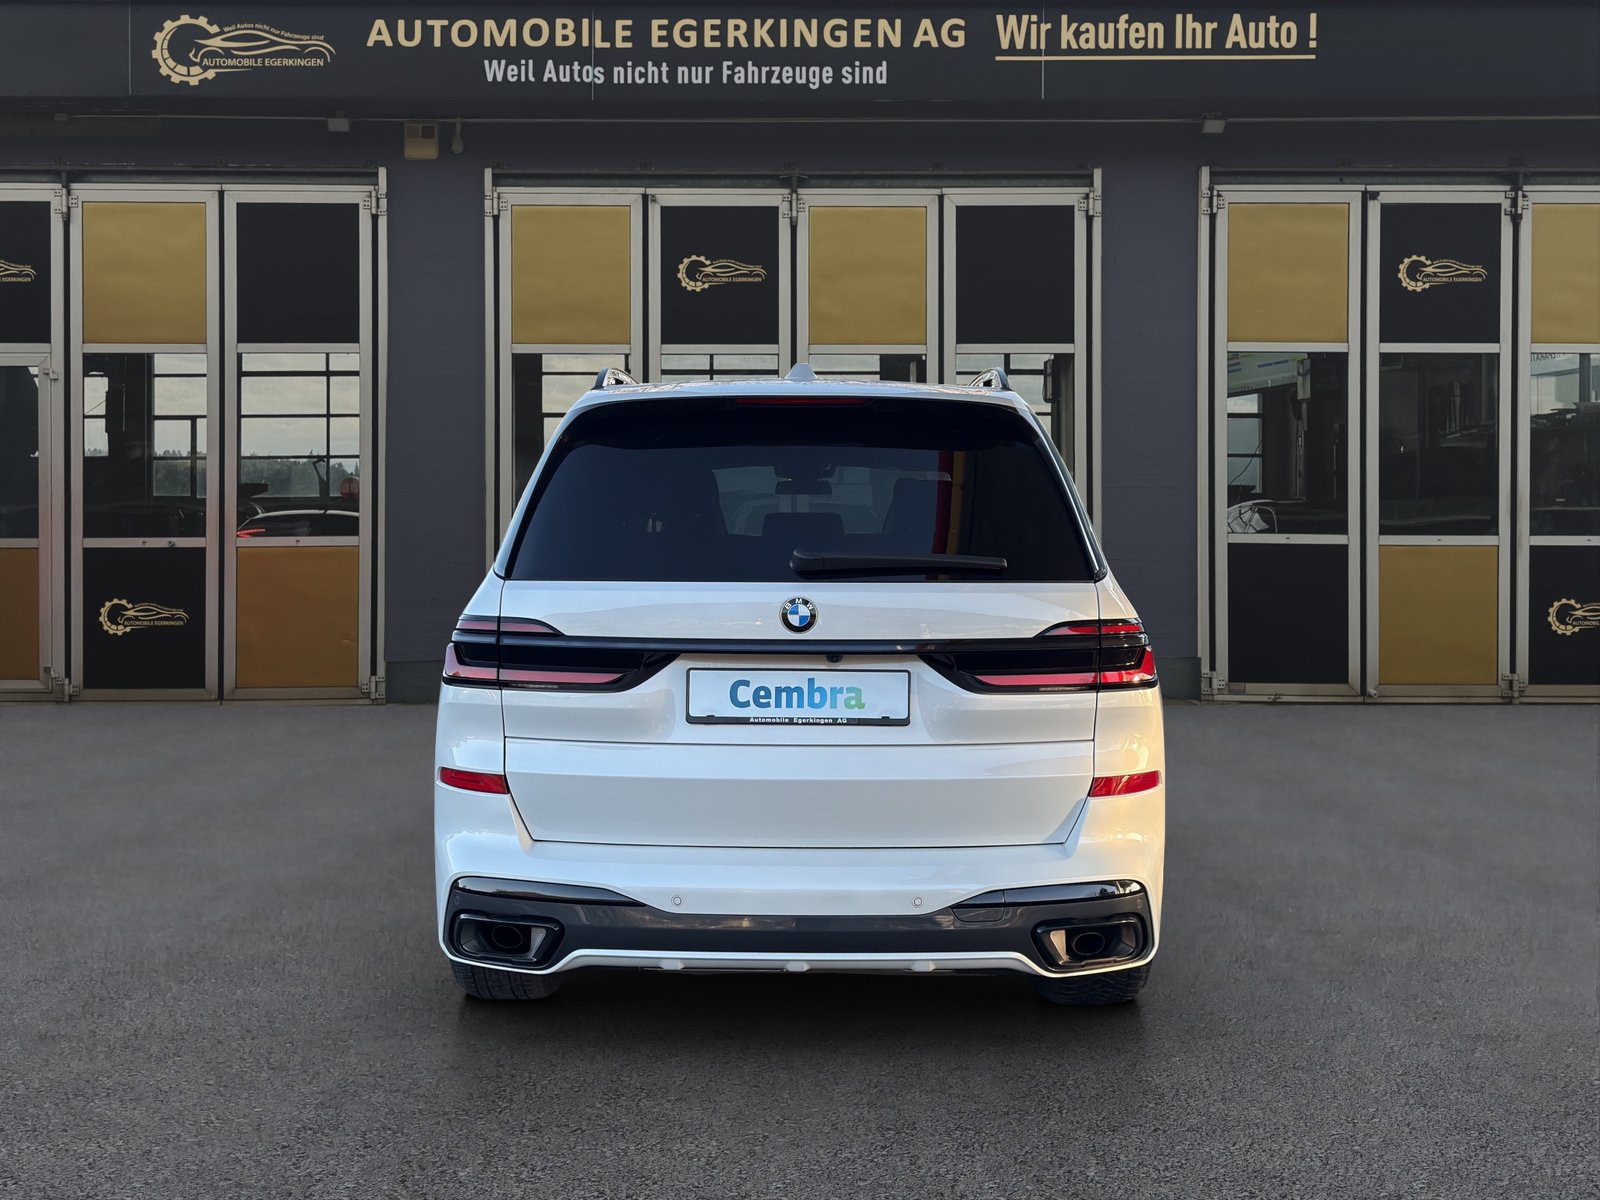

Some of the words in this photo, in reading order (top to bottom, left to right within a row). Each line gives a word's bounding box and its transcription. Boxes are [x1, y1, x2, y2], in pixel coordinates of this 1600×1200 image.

[366, 18, 633, 49] AUTOMOBILE
[651, 18, 902, 49] EGERKINGEN
[913, 18, 966, 48] AG
[995, 14, 1051, 50] Wir
[1060, 13, 1165, 50] kaufen
[1175, 13, 1218, 49] Ihr
[1224, 13, 1298, 49] Auto
[202, 58, 263, 67] AUTOMOBILE
[265, 58, 324, 67] EGERKINGEN
[484, 60, 535, 83] Weil
[543, 60, 605, 84] Autos
[613, 61, 669, 84] nicht
[677, 66, 714, 84] nur
[722, 61, 833, 90] Fahrzeuge
[842, 61, 887, 84] sind
[784, 598, 814, 610] BMW
[729, 677, 866, 710] Cembra
